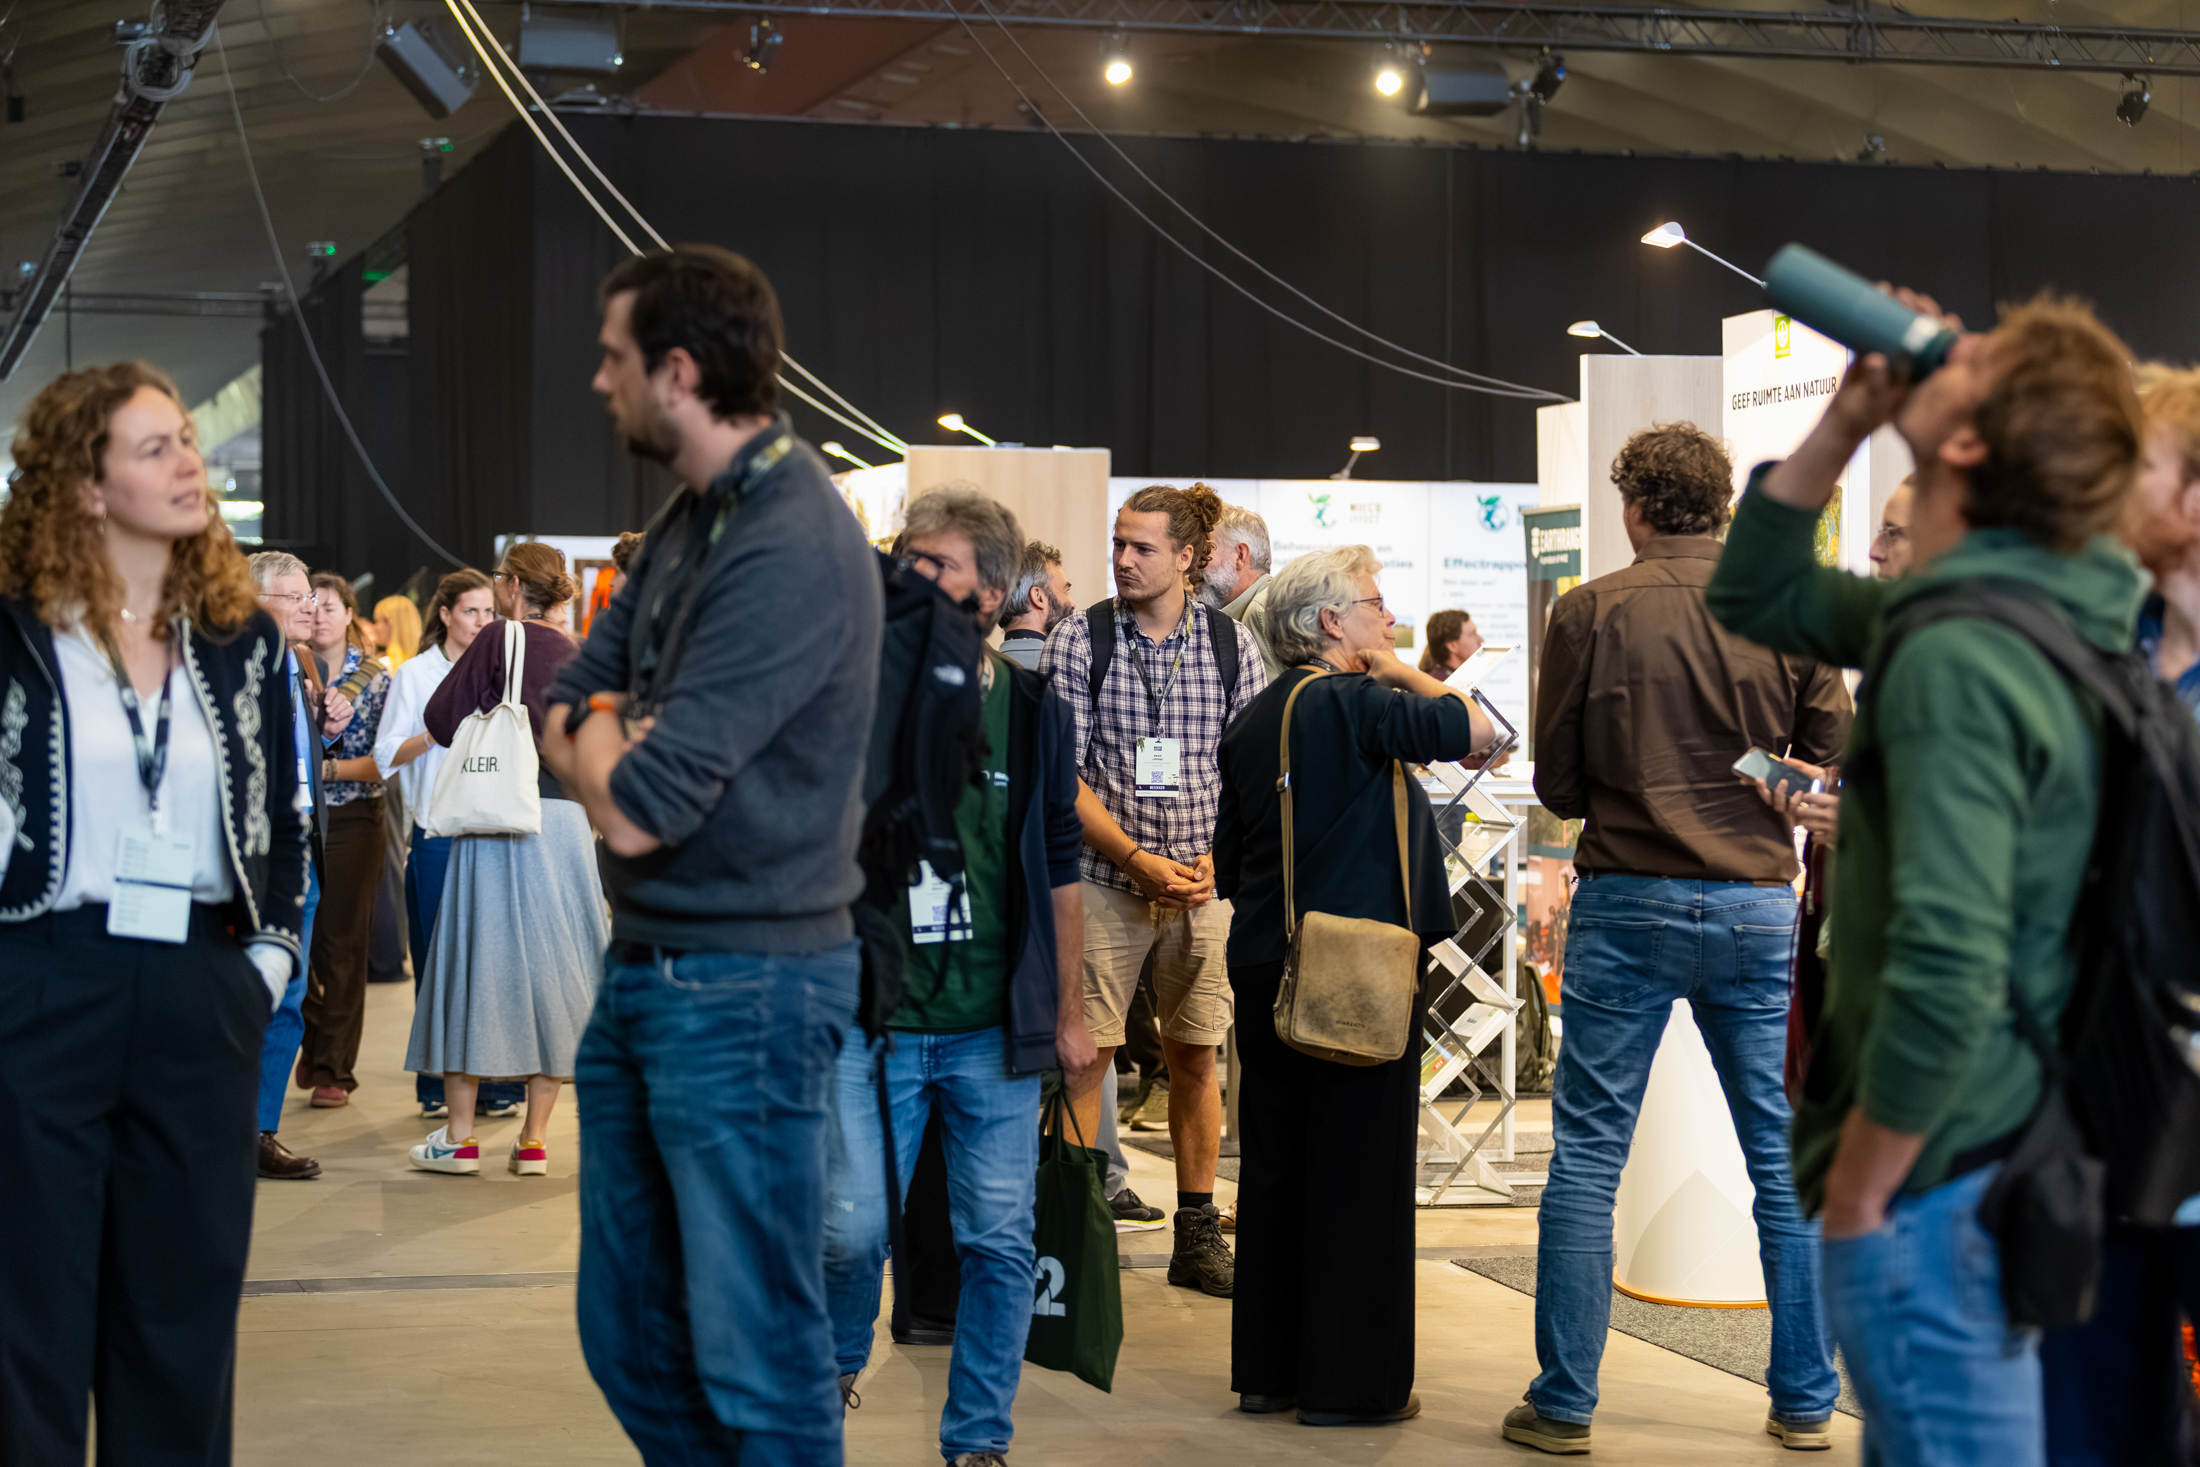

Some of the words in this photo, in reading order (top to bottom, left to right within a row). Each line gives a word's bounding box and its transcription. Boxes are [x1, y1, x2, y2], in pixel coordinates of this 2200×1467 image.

[1732, 392, 1751, 411] GEEF
[1752, 386, 1782, 407] RUIMTE
[1784, 382, 1801, 402] AAN
[1804, 376, 1837, 398] NATUUR
